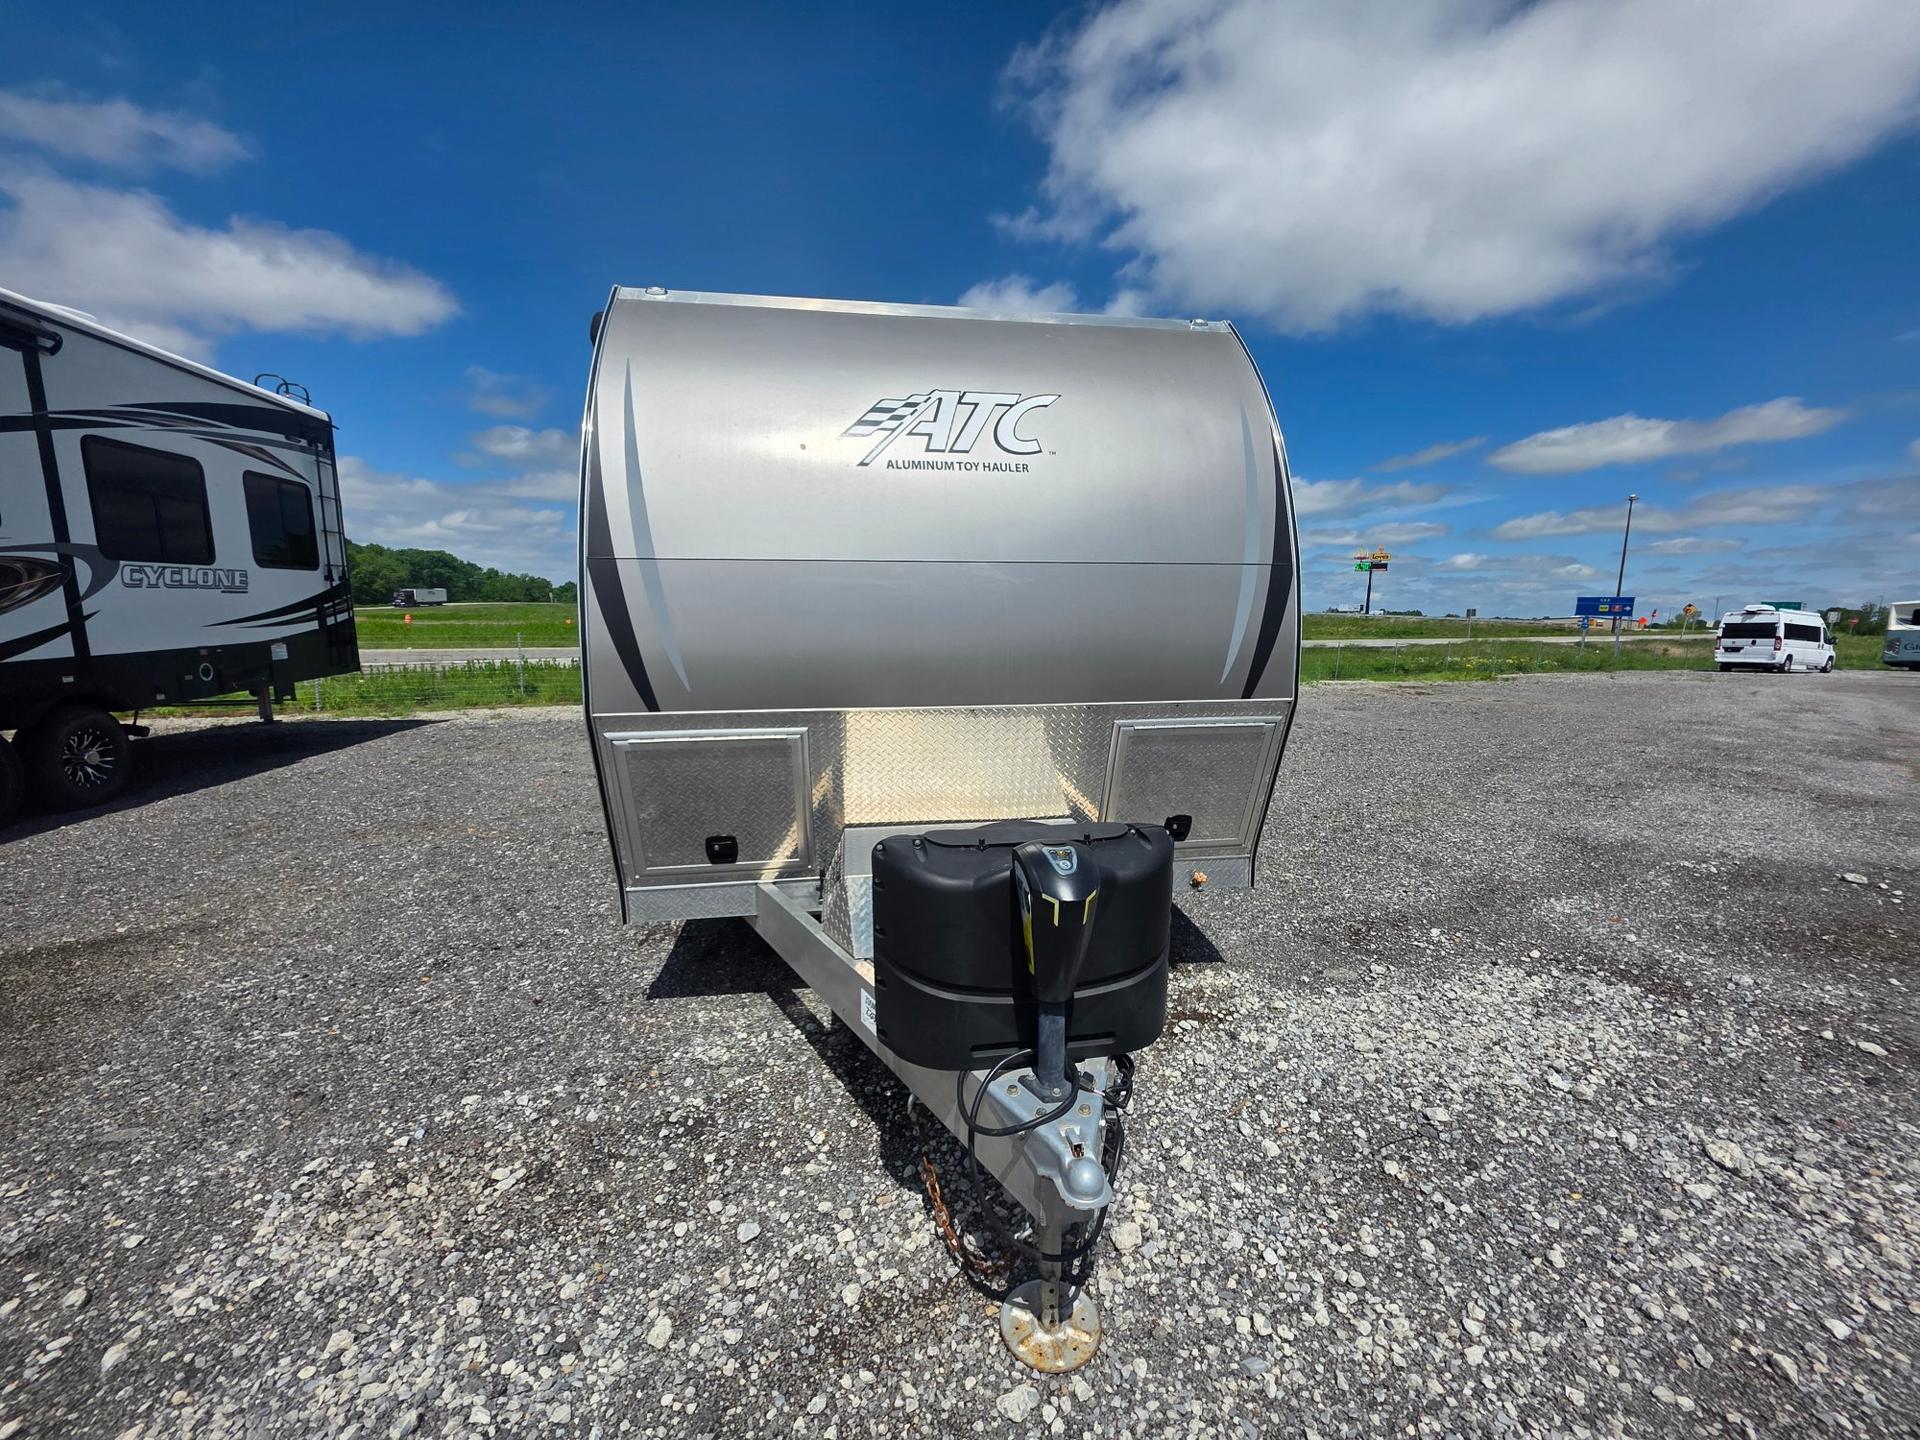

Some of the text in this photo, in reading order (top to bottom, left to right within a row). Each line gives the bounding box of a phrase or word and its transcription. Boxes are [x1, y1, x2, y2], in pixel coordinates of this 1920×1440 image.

[856, 389, 1062, 466] ATC
[886, 459, 1029, 473] ALUMINUM TOY HAULER
[121, 564, 249, 591] CYCLONE
